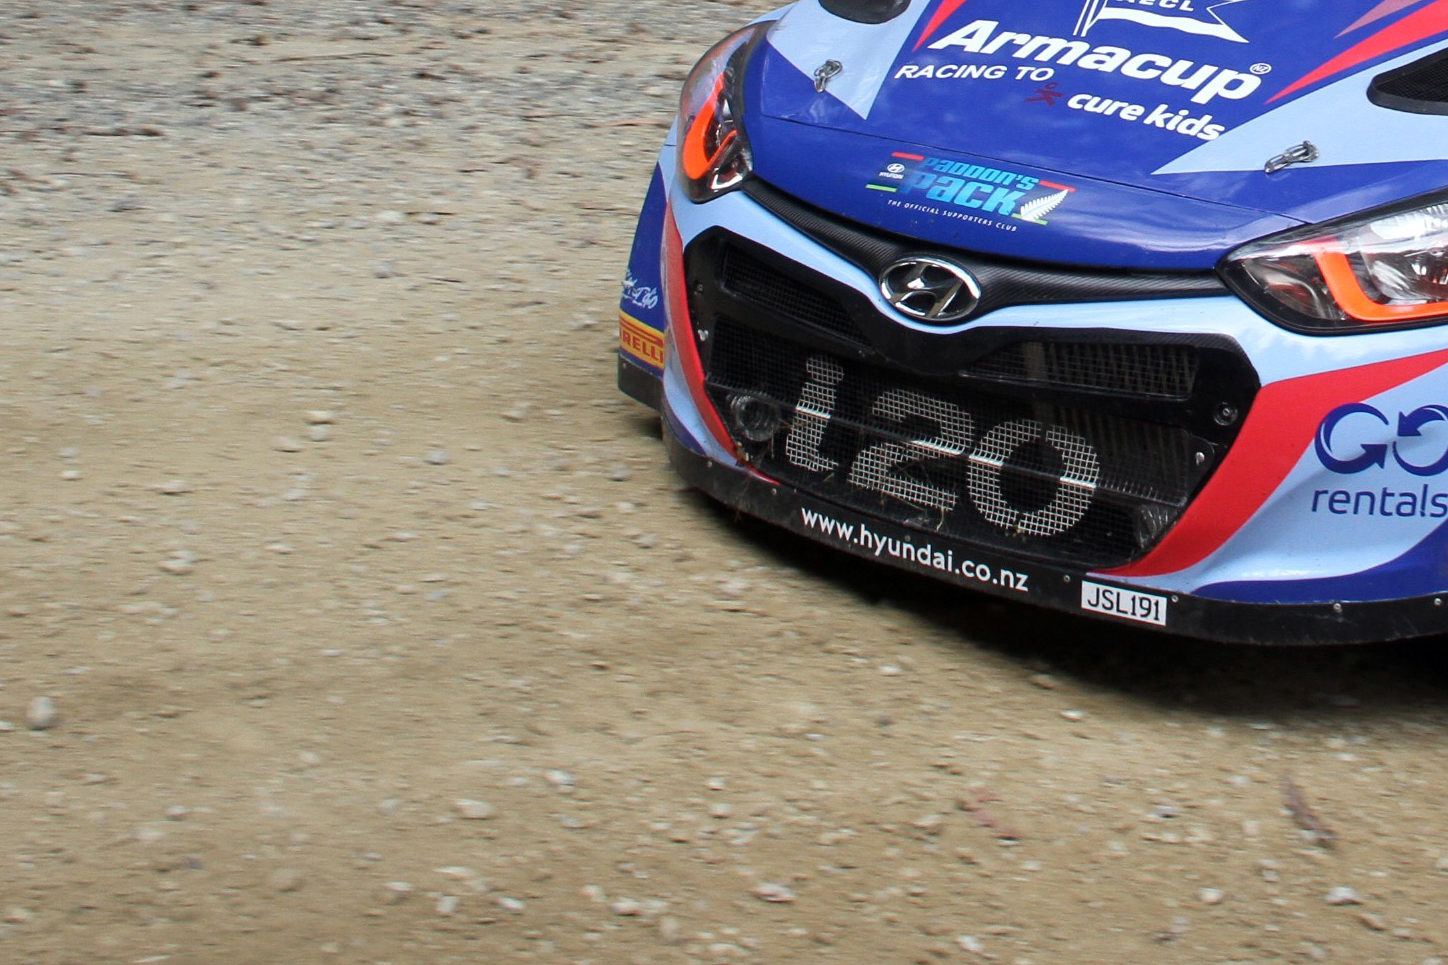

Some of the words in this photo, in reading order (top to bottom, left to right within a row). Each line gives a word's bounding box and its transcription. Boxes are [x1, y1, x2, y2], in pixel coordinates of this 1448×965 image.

[893, 64, 1008, 80] RACING
[1015, 66, 1055, 82] TO
[927, 20, 1262, 104] Armacup
[1067, 92, 1144, 123] cure
[1144, 103, 1225, 141] kids
[887, 199, 901, 207] THE
[904, 203, 939, 215] OFFICIAL
[942, 210, 993, 226] SUPPORTERS
[995, 222, 1017, 232] CLUB
[1311, 483, 1448, 518] rentals
[801, 507, 1029, 592] www.hyundai.co.nz
[1087, 586, 1161, 622] JSL191
